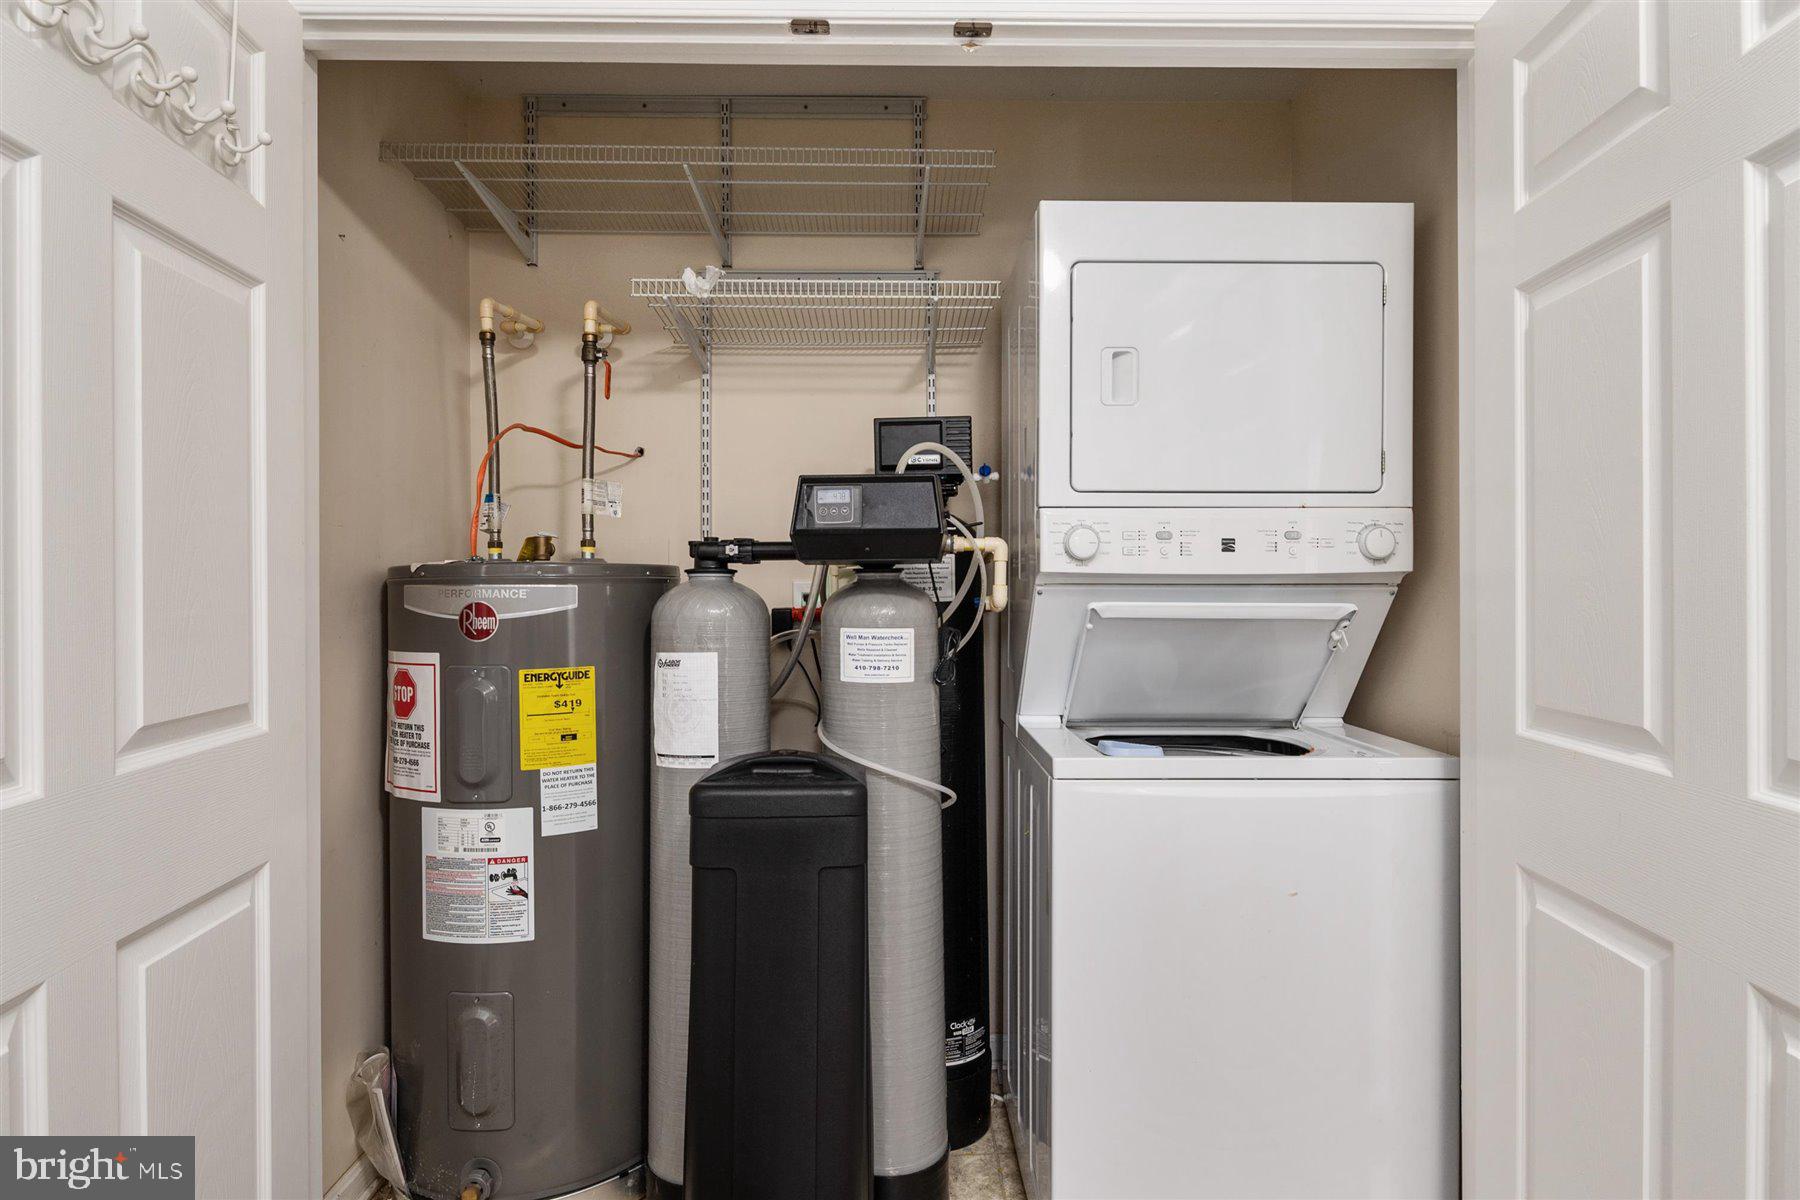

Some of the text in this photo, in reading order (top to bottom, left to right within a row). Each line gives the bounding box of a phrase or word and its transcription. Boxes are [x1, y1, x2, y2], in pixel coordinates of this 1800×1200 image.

[438, 588, 527, 599] PERFORMANCE
[463, 602, 496, 635] Rheem
[394, 685, 414, 702] STOP
[554, 699, 582, 708] $419
[414, 724, 424, 732] THIS
[399, 731, 414, 740] HEATER
[400, 739, 406, 747] OF
[406, 740, 430, 750] PURCHASE
[393, 756, 420, 766] 66-279-4566
[542, 799, 596, 812] 1-866-279-4566
